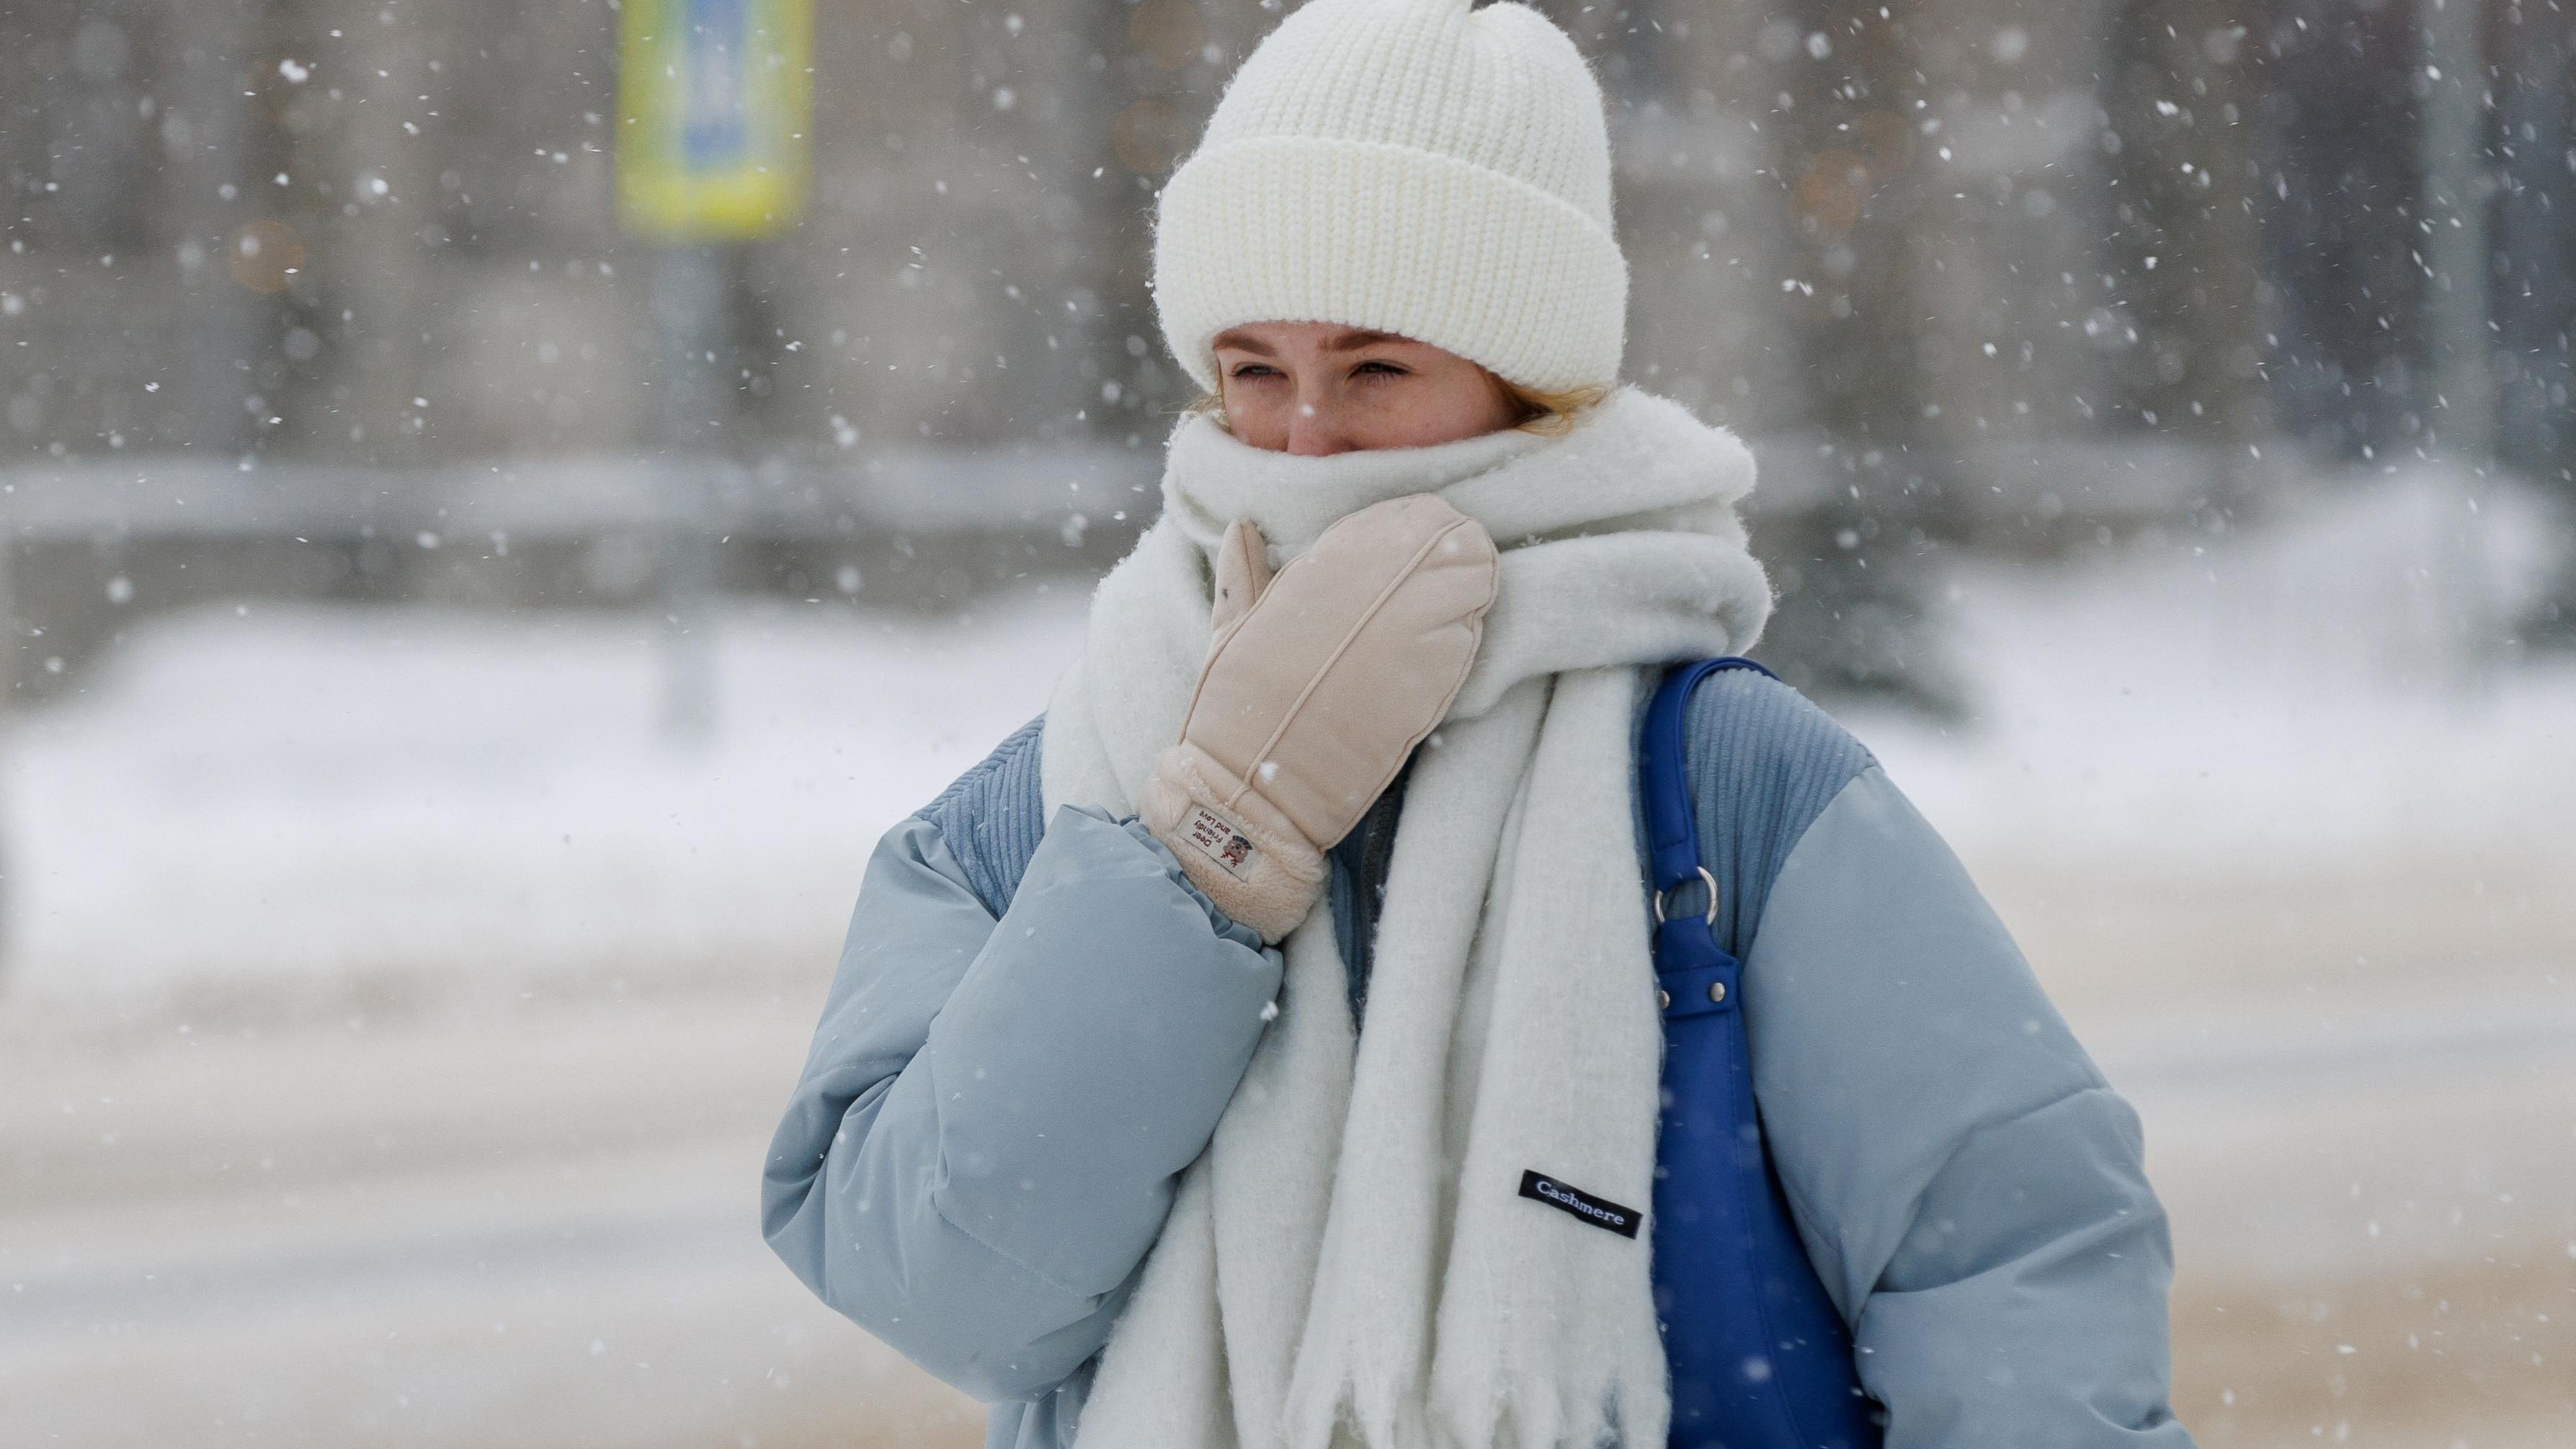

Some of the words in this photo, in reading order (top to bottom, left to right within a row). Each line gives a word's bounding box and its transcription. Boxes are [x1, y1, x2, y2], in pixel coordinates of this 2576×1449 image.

[1199, 811, 1216, 825] Love
[1193, 820, 1224, 844] Friendly
[1215, 822, 1231, 834] and
[1193, 832, 1212, 847] Deer
[1536, 1181, 1625, 1225] Cashmere
